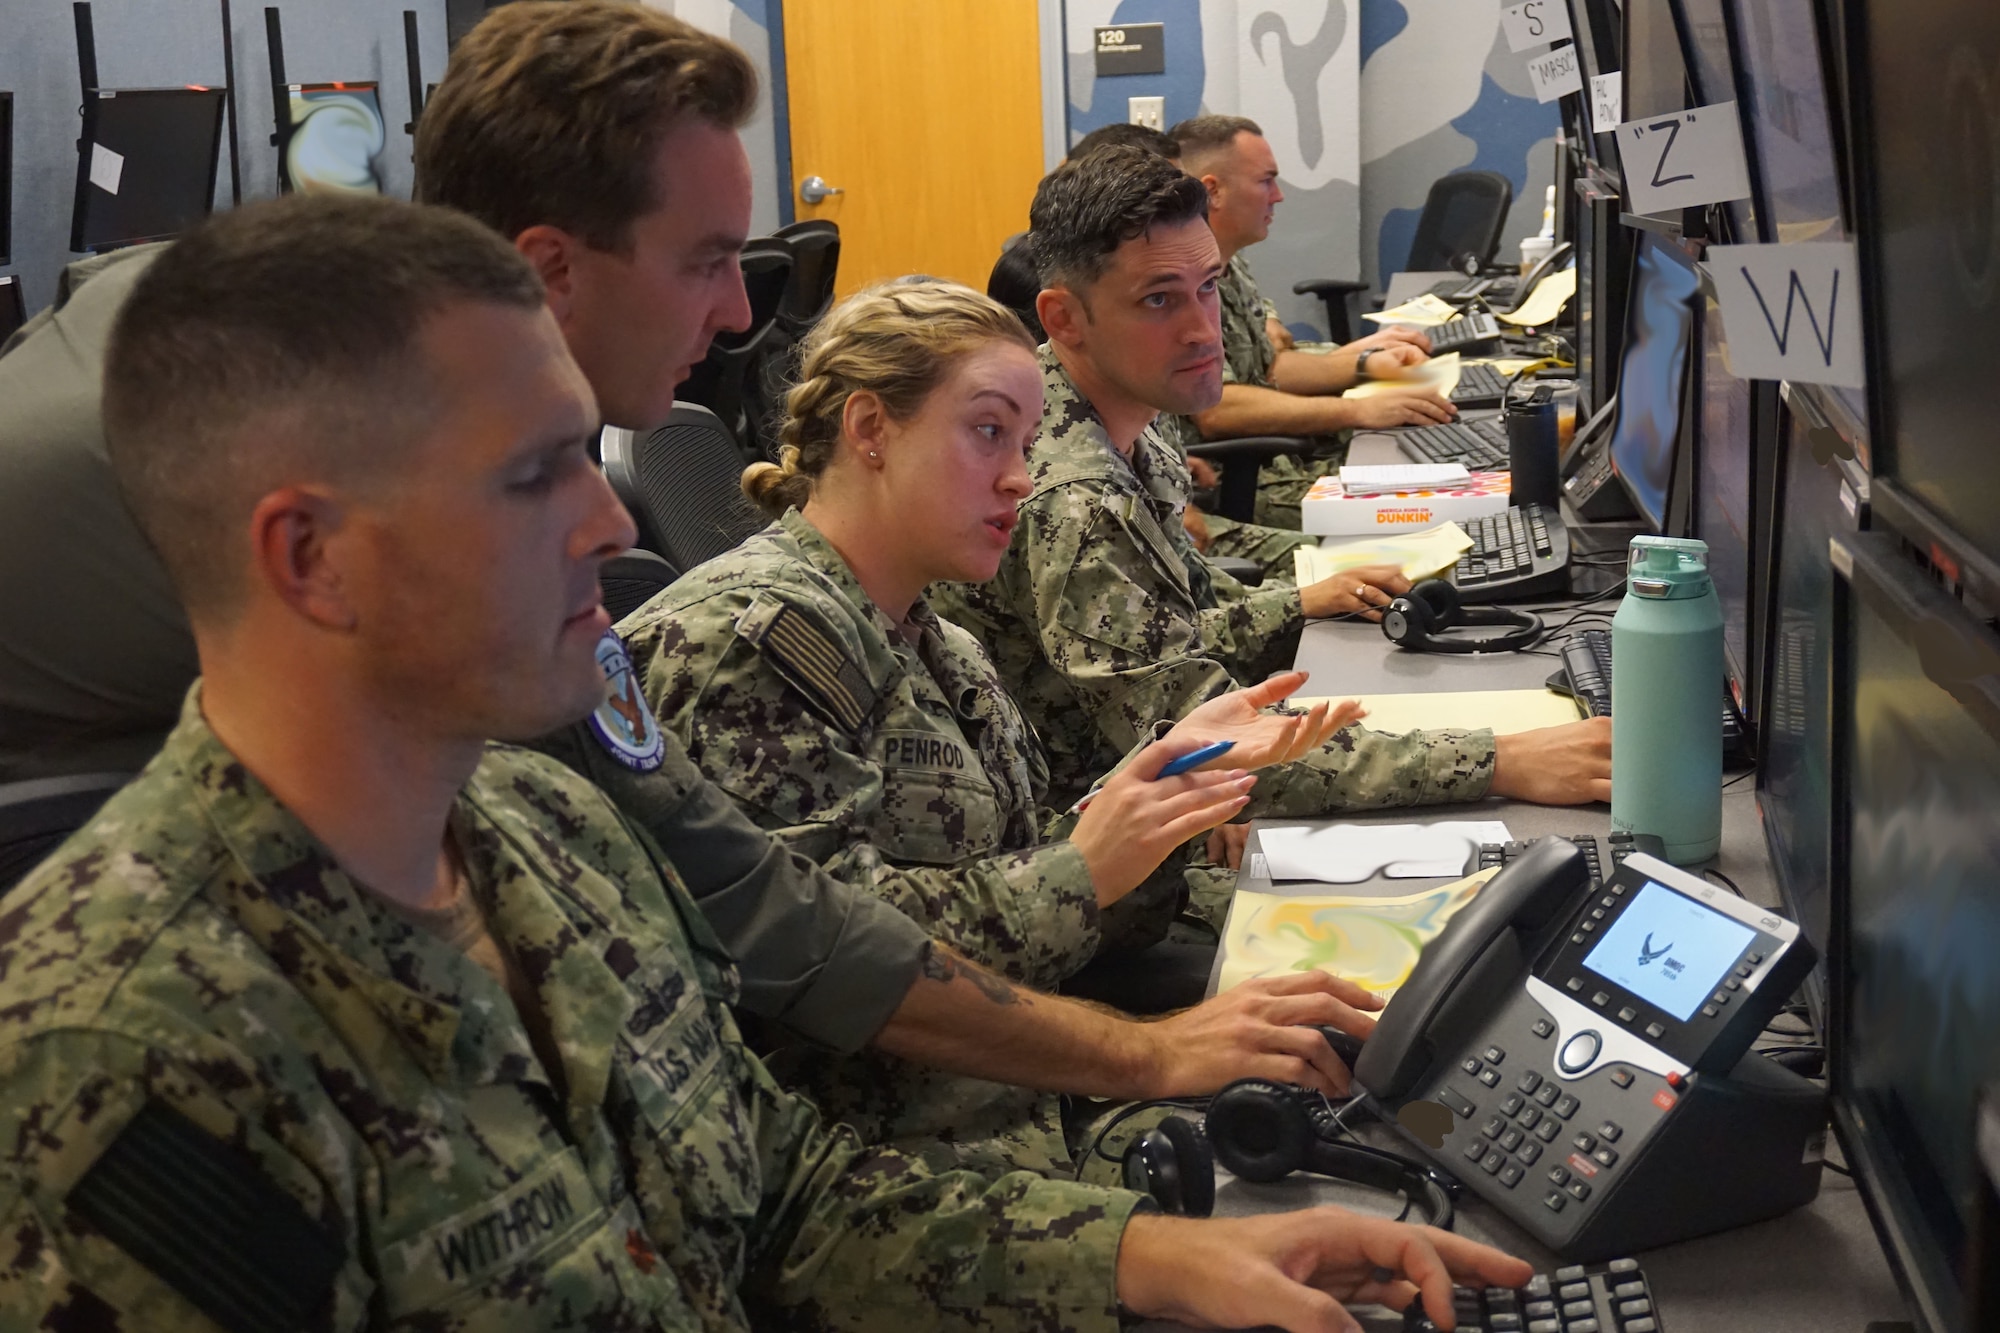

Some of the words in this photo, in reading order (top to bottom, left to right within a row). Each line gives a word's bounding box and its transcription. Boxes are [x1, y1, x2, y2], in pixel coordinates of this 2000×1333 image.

[1099, 30, 1126, 45] 120
[1634, 114, 1696, 187] "Z"
[1741, 266, 1840, 367] W
[1377, 512, 1433, 523] DUNKIN'
[885, 737, 964, 769] PENROD
[435, 1171, 575, 1281] WITHROW
